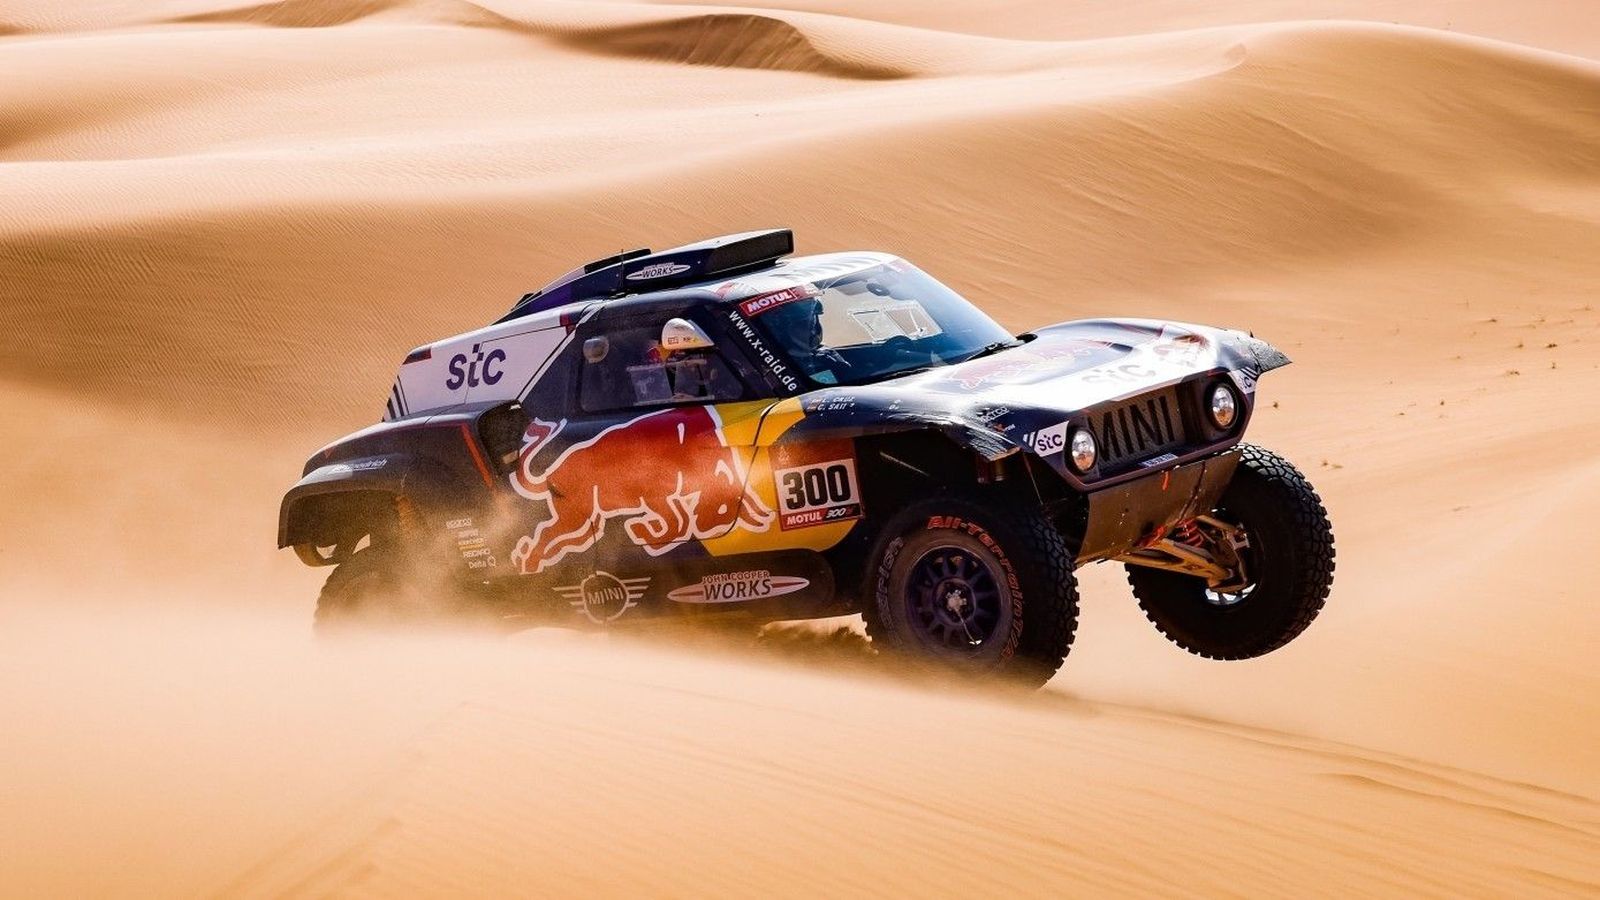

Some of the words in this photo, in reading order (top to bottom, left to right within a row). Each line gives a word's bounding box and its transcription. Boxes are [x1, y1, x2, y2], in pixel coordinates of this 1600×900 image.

[642, 266, 674, 278] WORKS
[747, 288, 793, 312] MOTUL
[729, 310, 798, 392] www.x-raid.de
[446, 343, 506, 390] stc
[1087, 396, 1175, 462] MINI
[1038, 434, 1063, 451] stc
[782, 464, 851, 511] 300
[787, 512, 823, 526] MOTUL
[702, 574, 728, 585] JOHN
[730, 569, 771, 581] COOPER
[588, 586, 625, 605] MINI
[703, 578, 772, 601] WORKS
